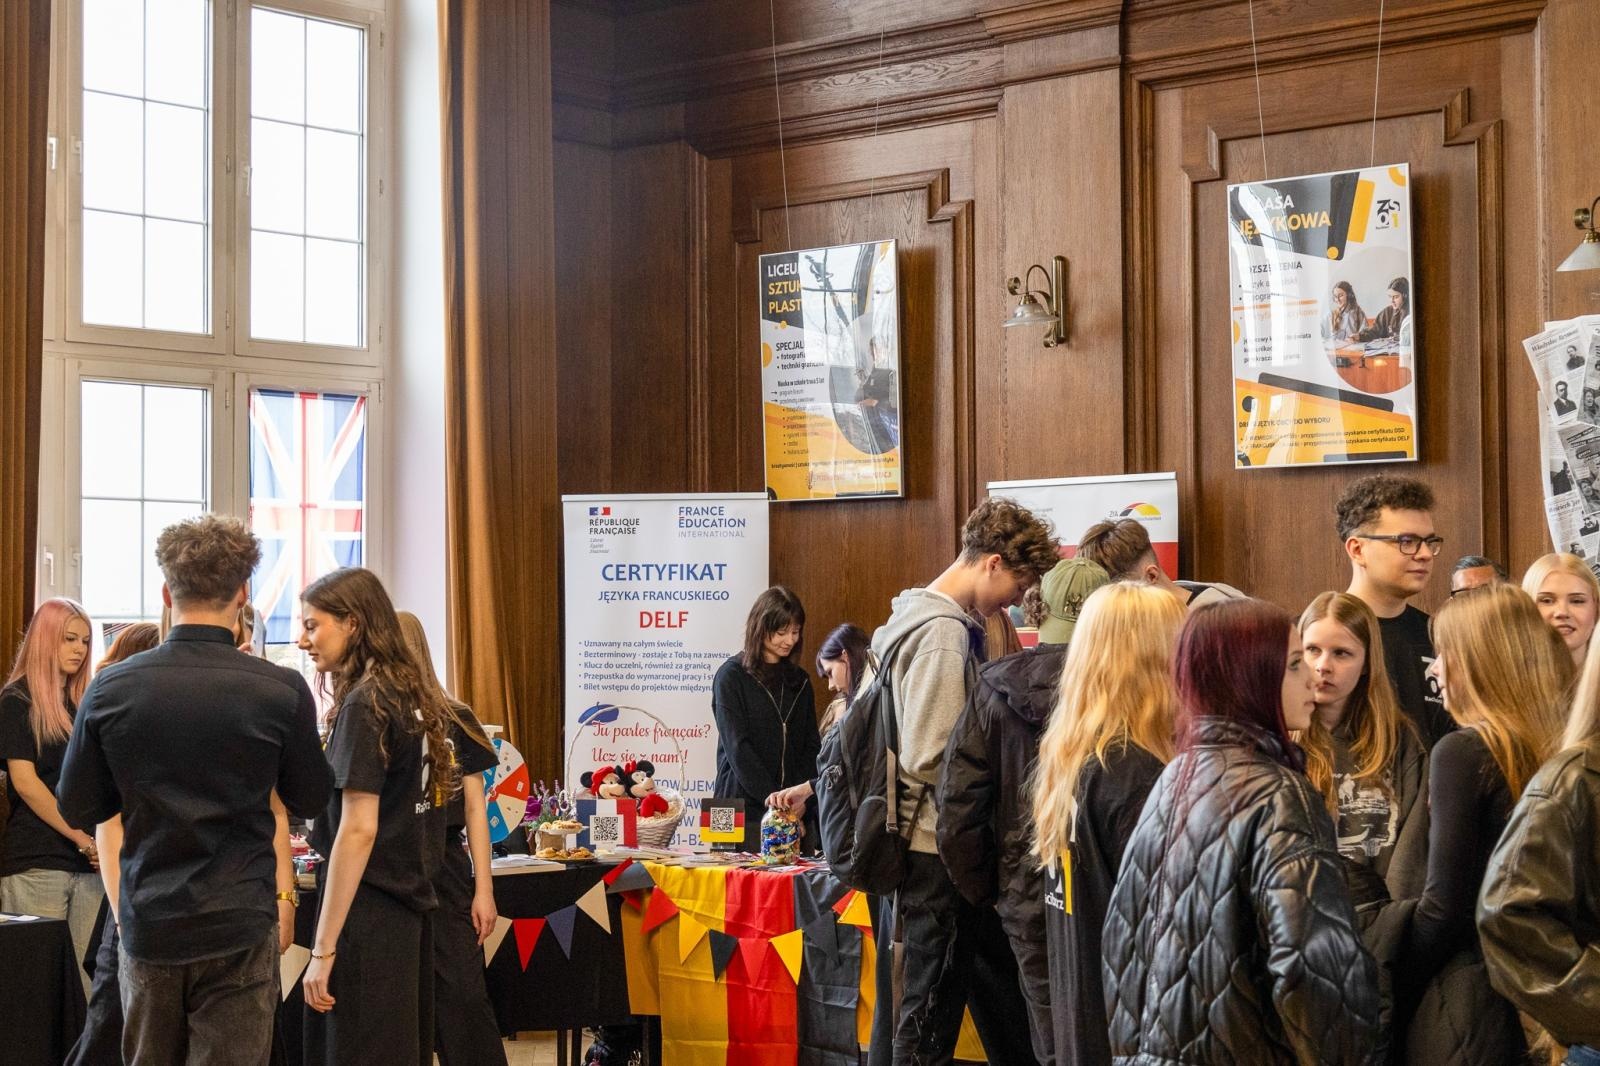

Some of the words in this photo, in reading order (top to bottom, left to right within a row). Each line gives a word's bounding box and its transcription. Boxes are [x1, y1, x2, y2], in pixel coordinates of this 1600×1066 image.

[1264, 194, 1295, 210] ASA
[767, 262, 800, 277] LICEU
[768, 300, 803, 314] PLAST
[775, 340, 805, 352] SPECJAL
[678, 506, 725, 516] FRANCE
[589, 517, 640, 528] RÉPUBLIQUE
[678, 516, 746, 528] ÉDUCATION
[589, 527, 637, 536] FRANÇAISE
[678, 530, 745, 538] INTERNATIONAL
[601, 563, 728, 582] CERTYFIKAT
[597, 590, 641, 604] JĘZYKA
[642, 590, 730, 601] FRANCUSKIEGO
[639, 611, 690, 628] DELF
[584, 640, 621, 648] Uznawany
[633, 640, 656, 648] całym
[656, 640, 684, 648] świecie
[583, 651, 637, 660] Bezterminowy
[642, 651, 667, 660] zostaje
[675, 651, 692, 660] Tobą
[584, 661, 602, 669] Klucz
[615, 662, 643, 670] uczelni,
[644, 661, 673, 669] również
[684, 662, 711, 671] granicą
[583, 672, 624, 681] Przepustka
[601, 684, 629, 692] wstępu
[630, 683, 640, 691] do
[641, 683, 679, 692] projektów
[680, 684, 714, 692] międzyn
[591, 720, 610, 737] Tu
[612, 721, 650, 743] parles
[591, 747, 617, 762] Ucz
[651, 749, 689, 764] nam!
